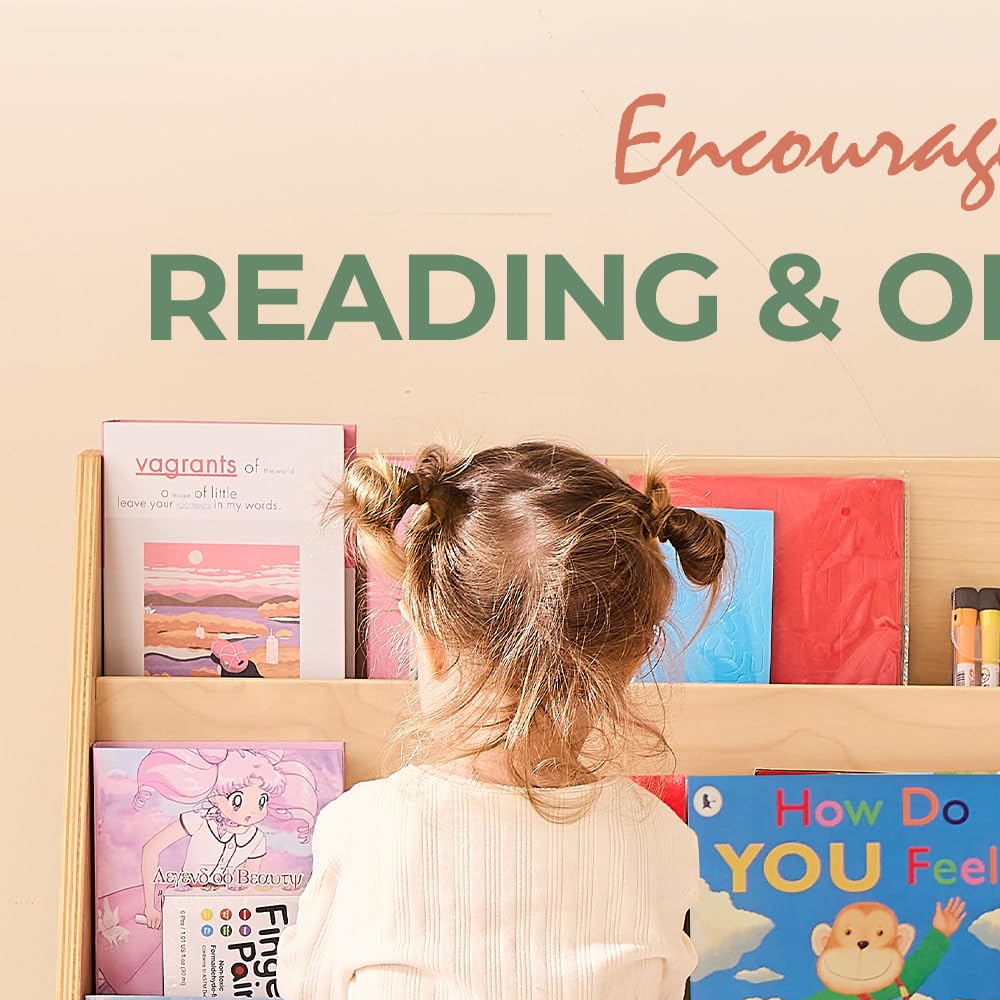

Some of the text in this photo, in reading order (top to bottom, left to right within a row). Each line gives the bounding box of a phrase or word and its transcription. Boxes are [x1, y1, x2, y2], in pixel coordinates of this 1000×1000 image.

[136, 455, 237, 479] vagrants
[244, 457, 260, 474] of
[117, 495, 147, 508] leave
[150, 500, 173, 513] your
[213, 499, 223, 509] in
[226, 501, 241, 512] my
[194, 485, 208, 499] of
[211, 485, 238, 499] little
[776, 786, 970, 828] How Do
[713, 842, 882, 893] YOU
